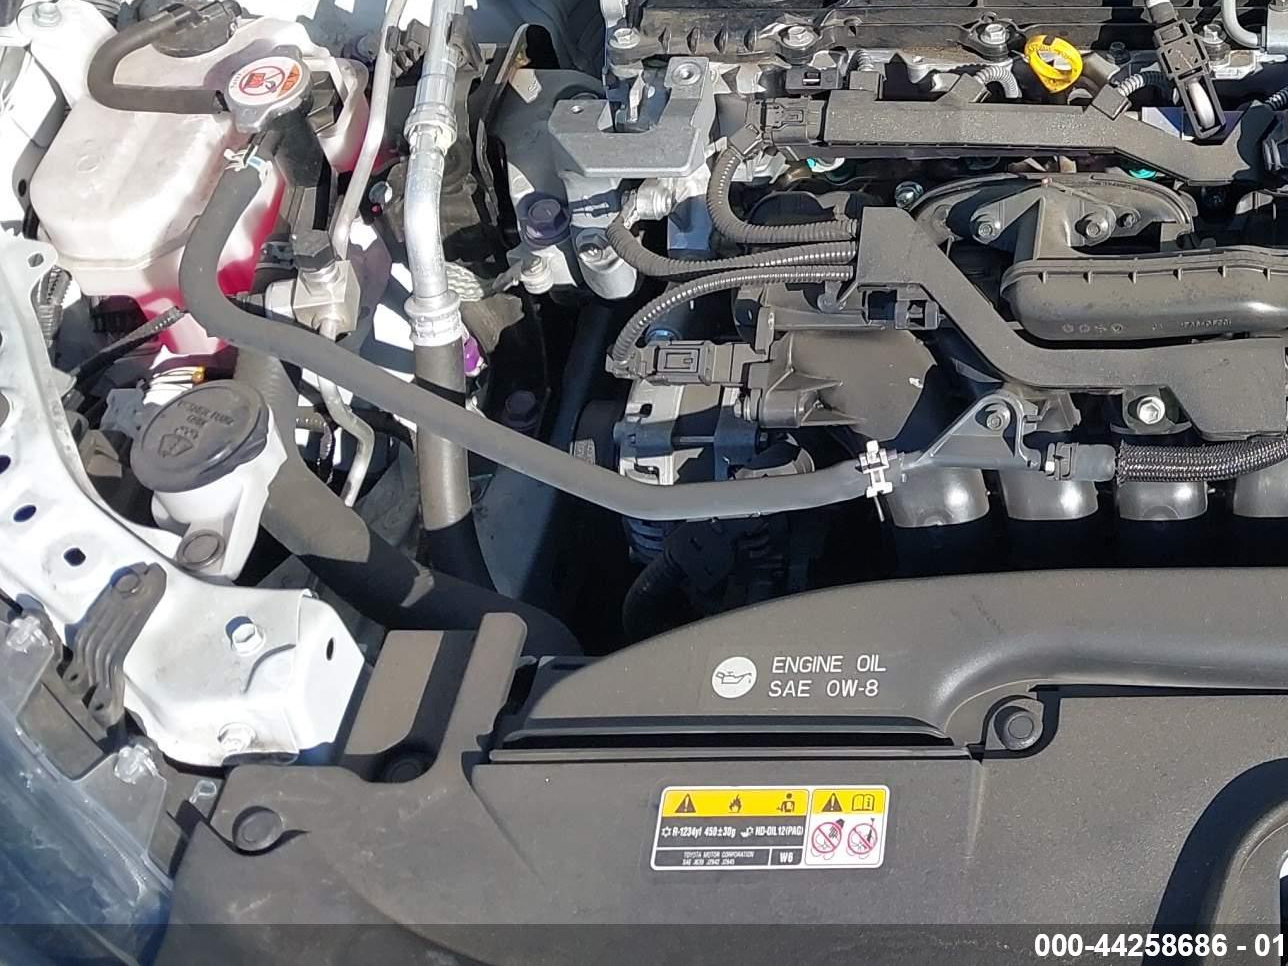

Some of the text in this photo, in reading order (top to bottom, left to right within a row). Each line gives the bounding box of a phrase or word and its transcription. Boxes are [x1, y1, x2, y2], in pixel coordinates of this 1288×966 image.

[772, 654, 887, 673] ENGINE OIL
[768, 678, 879, 698] SAE 0W-8
[672, 825, 702, 838] R-1234yf
[704, 825, 737, 838] 450±30g
[683, 850, 755, 859] TOYOTA MOTOR CORPORATION
